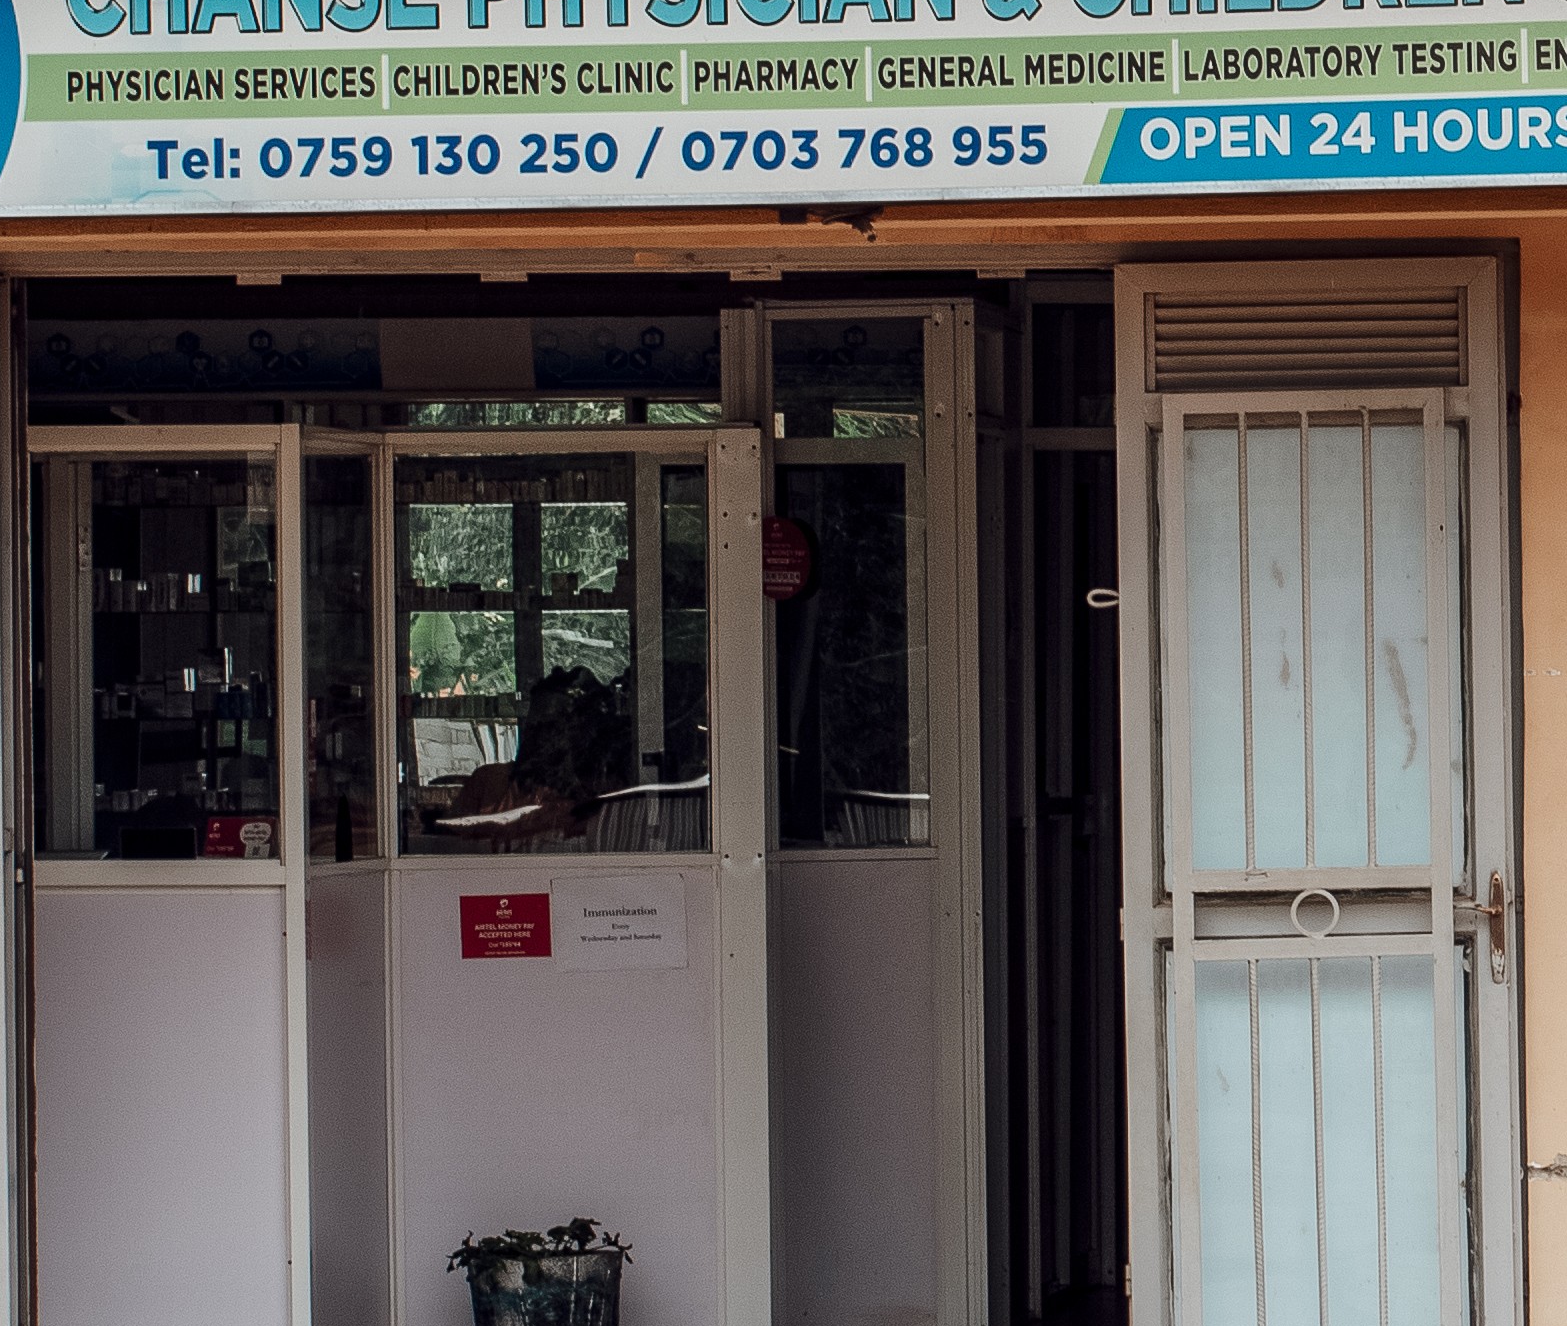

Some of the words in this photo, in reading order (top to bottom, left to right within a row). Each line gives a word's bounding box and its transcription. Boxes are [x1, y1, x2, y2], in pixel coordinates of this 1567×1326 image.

[577, 61, 675, 95] CLINIC
[694, 57, 859, 93] PHARMACY
[878, 54, 1014, 90] GENERAL
[1025, 50, 1165, 86] MEDICINE
[1184, 44, 1383, 82] LABORATORY
[1393, 39, 1517, 75] TESTING
[67, 69, 224, 103] PHYSICIAN
[234, 65, 376, 100] SERVICES
[147, 138, 240, 179] Tel:
[259, 136, 392, 178] 0759
[411, 134, 500, 175] 130
[519, 132, 619, 174] 250
[635, 126, 664, 179] /
[682, 129, 819, 171] 0703
[837, 127, 933, 168] 768
[952, 124, 1048, 166] 955
[1140, 113, 1291, 161] OPEN
[1309, 111, 1375, 154] 24
[583, 905, 658, 918] Immunization
